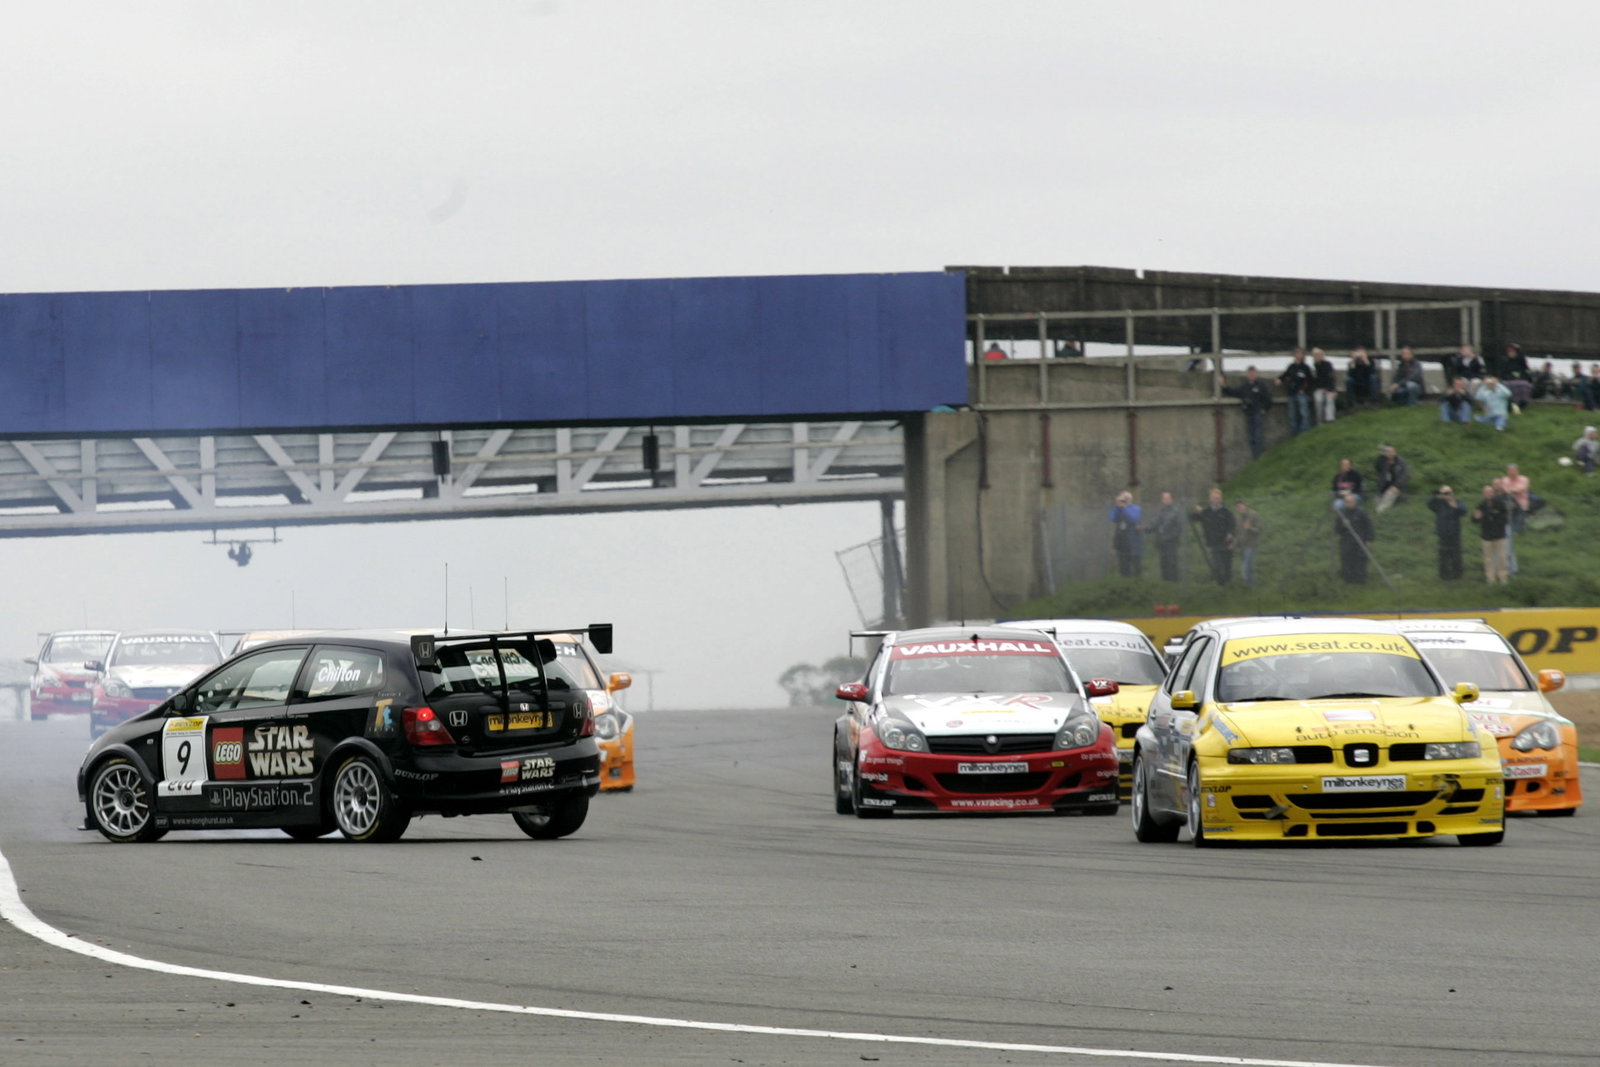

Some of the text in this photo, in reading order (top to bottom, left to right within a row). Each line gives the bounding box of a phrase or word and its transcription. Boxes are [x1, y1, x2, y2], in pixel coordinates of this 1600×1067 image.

[121, 635, 211, 645] VAUXHALL
[900, 642, 1052, 656] VAUXHALL
[1233, 640, 1407, 658] www.seat.co.uk
[318, 665, 361, 682] Chilton
[248, 725, 314, 751] STAR
[1296, 729, 1338, 741] auto
[177, 740, 192, 776] 9
[215, 744, 241, 762] LEGO
[248, 750, 314, 777] WARS
[522, 757, 556, 770] STAR
[394, 768, 439, 781] DUNLOP
[521, 767, 556, 780] WARS
[1324, 776, 1405, 789] miltonkeynes
[222, 782, 314, 811] PlayStation 2
[951, 798, 1039, 808] www.vxracing.co.uk
